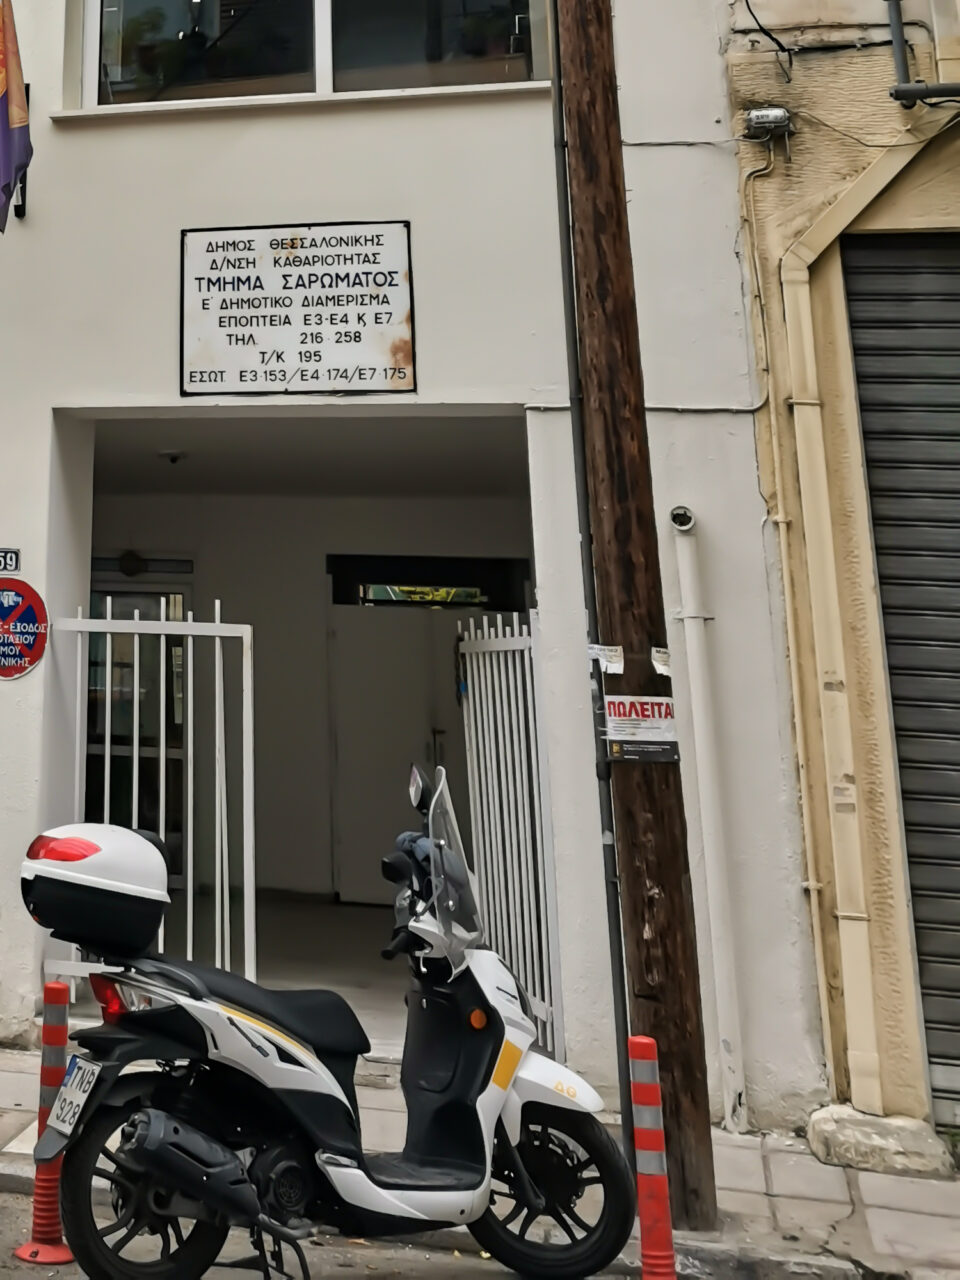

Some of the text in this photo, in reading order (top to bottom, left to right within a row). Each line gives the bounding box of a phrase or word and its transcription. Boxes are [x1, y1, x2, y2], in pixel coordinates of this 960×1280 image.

[206, 234, 385, 253] ΔΗΜΟΣ ΘΕΣΣΑΛΟΝΙΚΗΣ
[210, 253, 381, 271] Δ/ΝΣΗ ΚΑΘΑΡΙΟΤΗΤΑΣ
[194, 271, 400, 293] ΤΜΗΜΑ ΣΑΡΩΜΑΤΟΣ
[219, 296, 293, 310] ΔΗΜΟΤΙΚΟ
[301, 294, 391, 308] ΔΙΑΜΕΡΙΣΜΑ
[218, 314, 292, 328] ΕΠΟΠΤΕΙΑ
[298, 350, 322, 363] 195
[56, 1097, 81, 1127] 928
